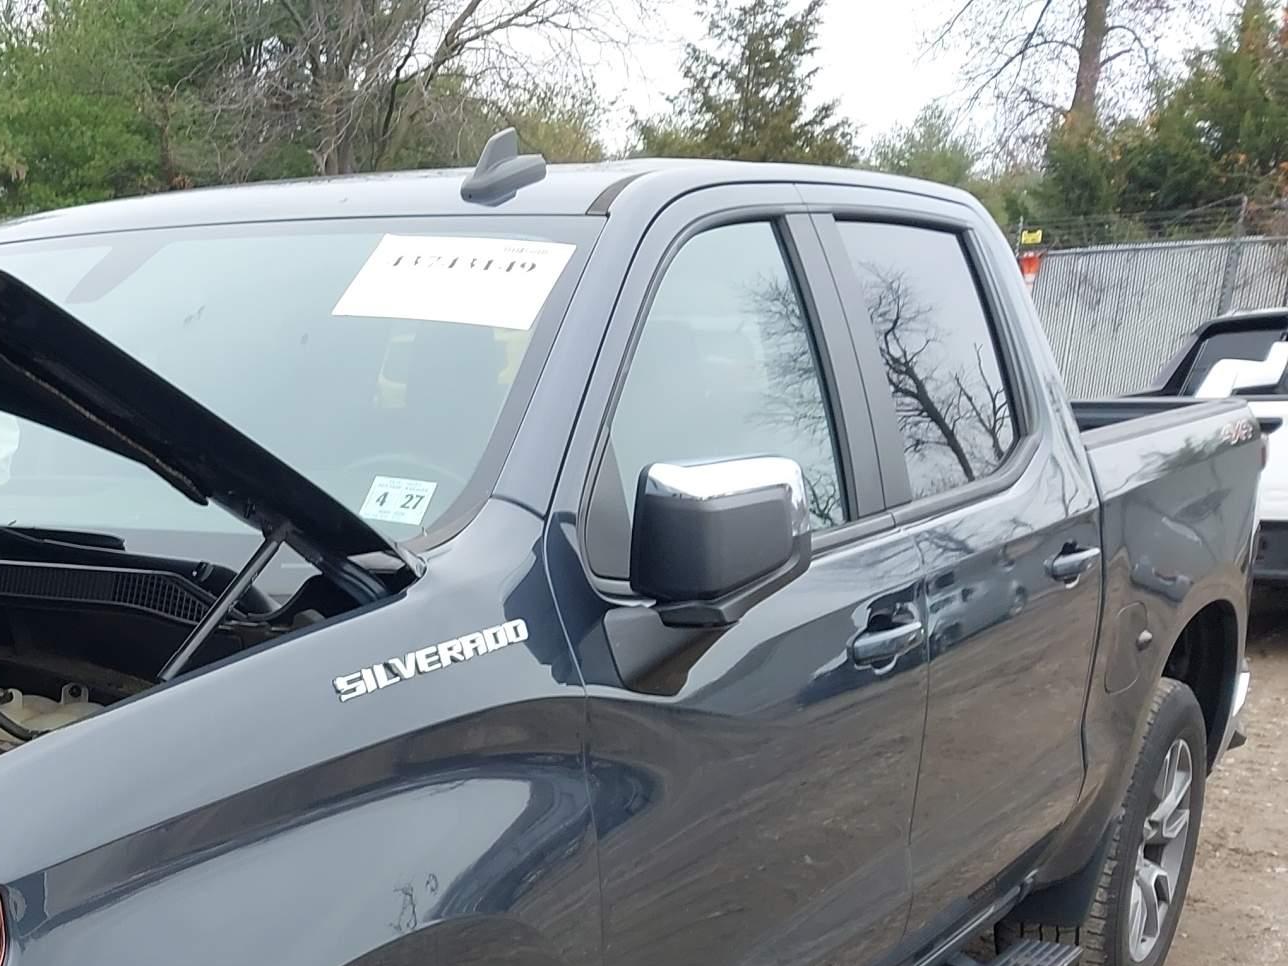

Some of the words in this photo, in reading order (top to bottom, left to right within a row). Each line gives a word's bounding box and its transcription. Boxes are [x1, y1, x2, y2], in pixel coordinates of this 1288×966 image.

[376, 491, 390, 507] 4
[400, 494, 426, 510] 27
[332, 618, 529, 702] SILVERADO
